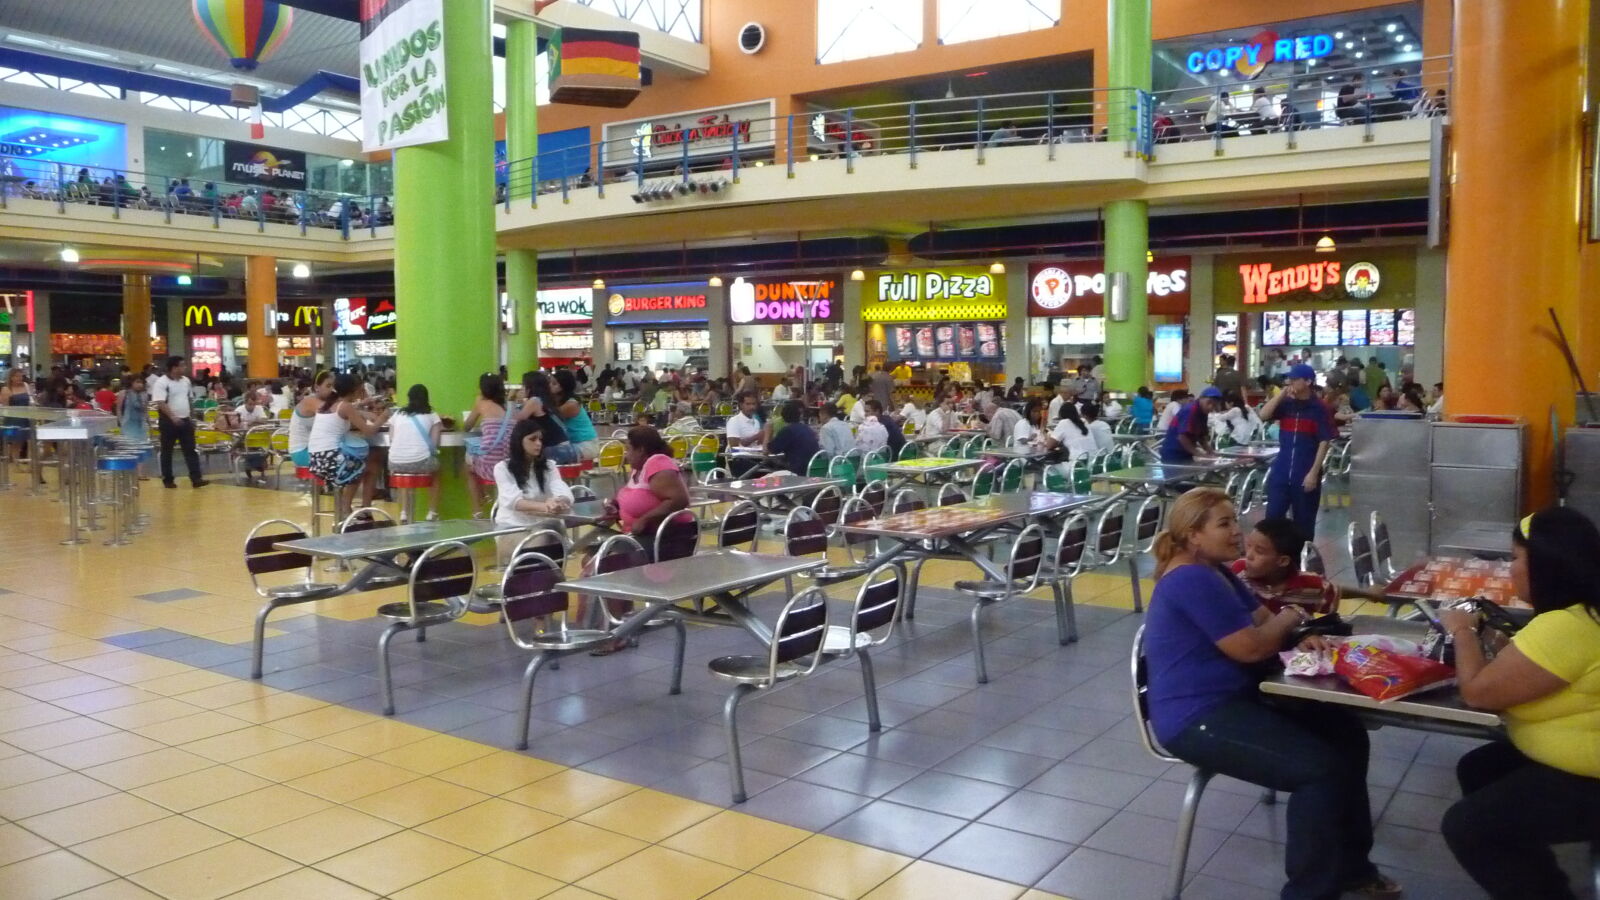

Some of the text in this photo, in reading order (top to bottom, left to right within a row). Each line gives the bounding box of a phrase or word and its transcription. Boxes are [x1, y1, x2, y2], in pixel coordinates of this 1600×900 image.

[363, 19, 441, 88] UNIDOS
[1186, 33, 1334, 73] COPY RED
[381, 58, 437, 108] POR LA
[377, 84, 446, 147] PASIÓN
[557, 296, 587, 314] wok
[624, 296, 673, 311] BURGER
[674, 294, 706, 309] KING
[878, 271, 991, 302] Full Pizza
